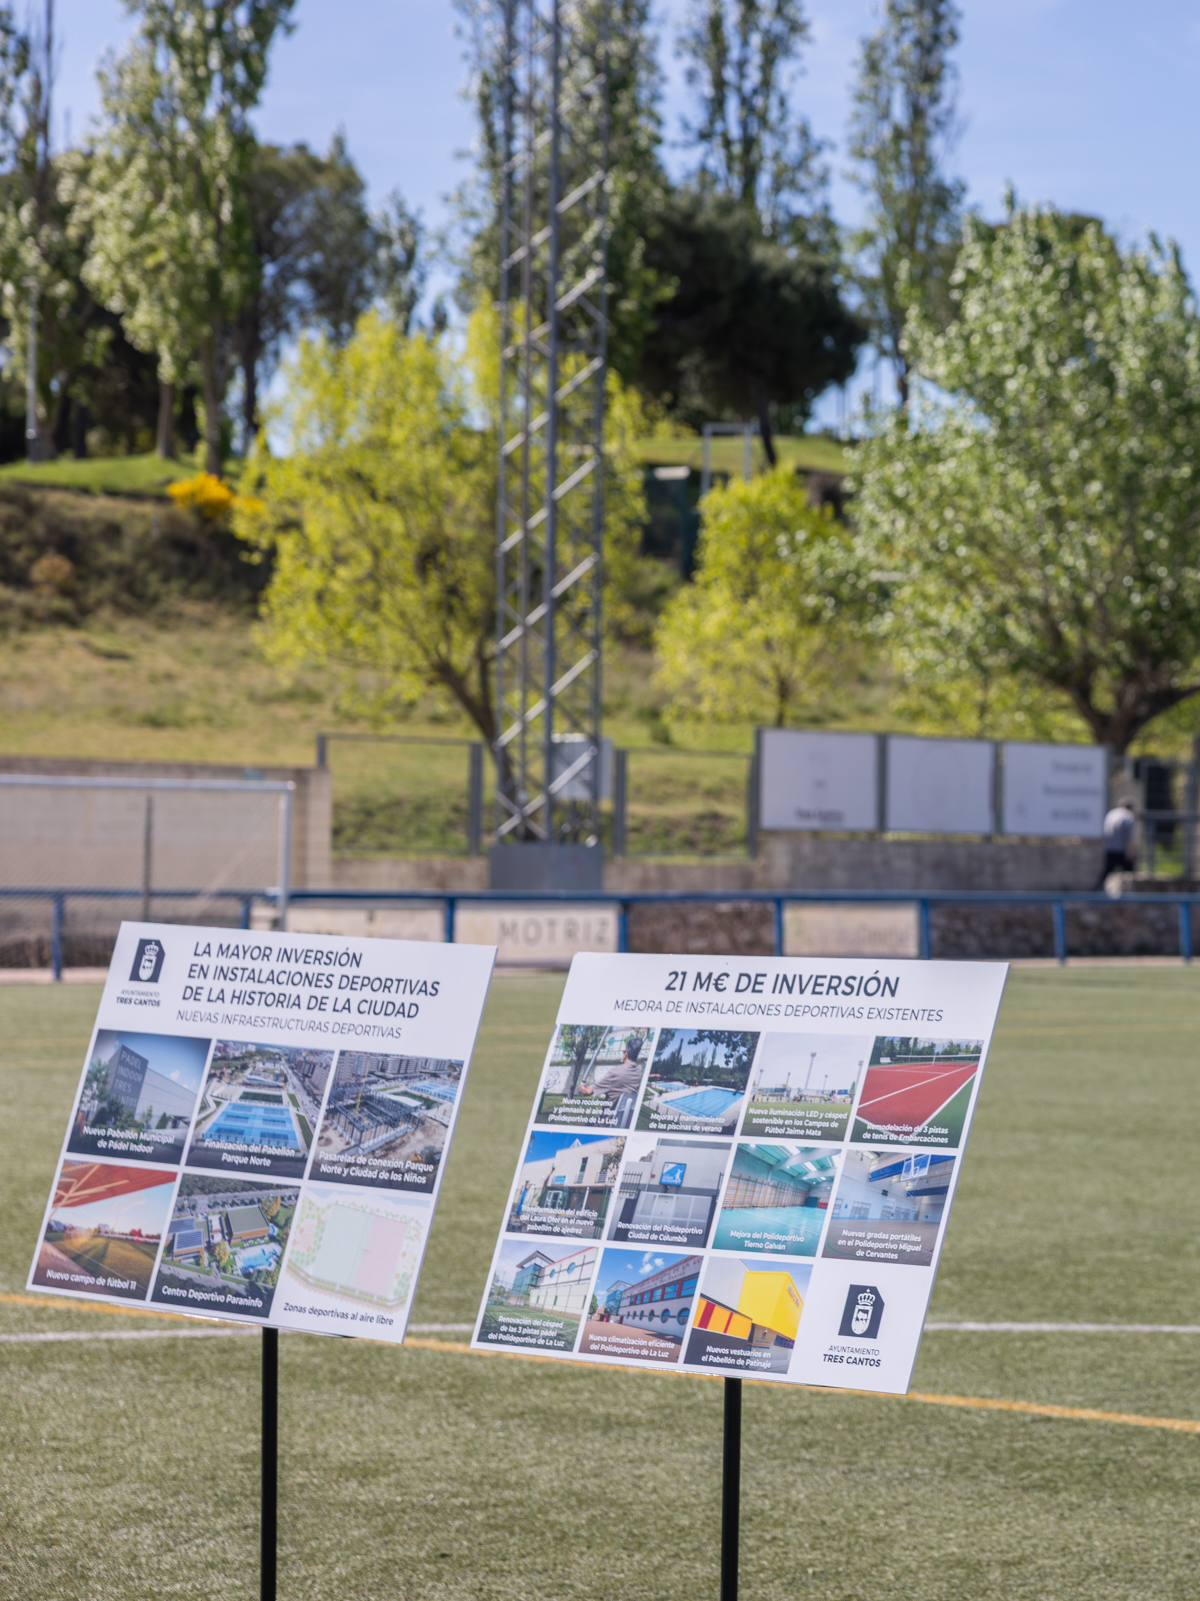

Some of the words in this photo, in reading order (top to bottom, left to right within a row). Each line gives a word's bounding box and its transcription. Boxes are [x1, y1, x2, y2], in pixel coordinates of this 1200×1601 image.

[499, 916, 608, 947] MOTRIZ
[194, 942, 212, 957] LA
[216, 943, 271, 962] MAYOR
[276, 947, 362, 968] INVERSIÓN
[188, 964, 208, 980] EN
[213, 966, 333, 989] INSTALACIONES
[339, 976, 440, 996] DEPORTIVAS
[665, 971, 687, 991] 21
[692, 972, 730, 993] M€
[735, 973, 767, 993] DE
[772, 970, 899, 998] INVERSIÓN
[116, 996, 132, 1005] TRES
[134, 998, 161, 1007] CANTOS
[182, 987, 202, 1001] DE
[208, 988, 225, 1002] LA
[231, 989, 301, 1010] HISTORIA
[307, 996, 328, 1011] DE
[333, 998, 351, 1013] LA
[357, 1000, 419, 1018] CIUDAD
[614, 999, 662, 1012] MEJORA
[666, 1000, 683, 1013] DE
[685, 1002, 781, 1017] INSTALACIONES
[784, 1005, 864, 1019] DEPORTIVAS
[867, 1007, 943, 1022] EXISTENTES
[177, 1011, 219, 1024] NUEVAS
[221, 1013, 329, 1033] INFRAESTRUCTURAS
[332, 1022, 402, 1039] DEPORTIVAS
[650, 1113, 673, 1122] Mejoras
[680, 1115, 725, 1123] mantenimiento
[749, 1108, 767, 1116] Nueva
[769, 1108, 805, 1118] iluminación
[806, 1110, 818, 1118] LED
[826, 1111, 847, 1120] césped
[752, 1117, 783, 1126] sostenible
[794, 1119, 803, 1127] los
[804, 1120, 829, 1128] Campos
[867, 1124, 913, 1133] Remodelación
[914, 1125, 922, 1133] de
[929, 1126, 949, 1135] pistas
[83, 1126, 105, 1137] Nuevo
[107, 1128, 138, 1140] Pabellón
[140, 1130, 174, 1144] Municipal
[765, 1127, 784, 1135] Fútbol
[786, 1127, 804, 1136] Jaime
[806, 1128, 821, 1136] Mata
[872, 1132, 887, 1140] tenis
[889, 1133, 897, 1141] de
[899, 1134, 949, 1144] Embarcaciones
[98, 1140, 107, 1148] de
[108, 1140, 128, 1151] Pádel
[130, 1143, 153, 1153] Indoor
[204, 1139, 247, 1152] Finalización
[249, 1143, 261, 1153] del
[263, 1144, 295, 1157] Pabellón
[222, 1153, 248, 1166] Parque
[250, 1157, 272, 1167] Norte
[319, 1152, 355, 1163] Pasarelas
[357, 1156, 367, 1165] de
[368, 1155, 403, 1168] conexión
[405, 1160, 434, 1172] Parque
[320, 1164, 341, 1174] Norte
[342, 1168, 349, 1177] y
[350, 1167, 378, 1179] Ciudad
[379, 1170, 389, 1179] de
[391, 1172, 402, 1181] los
[403, 1173, 426, 1184] Niños
[617, 1221, 651, 1230] Renovación
[653, 1224, 662, 1232] del
[663, 1225, 703, 1235] Polideportivo
[628, 1231, 649, 1240] Ciudad
[658, 1234, 687, 1243] Columbia
[730, 1230, 751, 1239] Mejora
[763, 1232, 804, 1243] Polideportivo
[842, 1229, 865, 1239] Nuevas
[867, 1231, 889, 1241] gradas
[890, 1232, 921, 1243] portátiles
[744, 1240, 762, 1249] Tierno
[764, 1241, 786, 1250] Galván
[847, 1238, 854, 1246] el
[855, 1239, 897, 1250] Polideportivo
[899, 1242, 921, 1252] Miguel
[867, 1249, 898, 1260] Cervantes
[46, 1269, 69, 1281] Nuevo
[71, 1275, 94, 1286] campo
[96, 1276, 106, 1286] de
[107, 1276, 129, 1289] fútbol
[130, 1280, 136, 1290] 11
[162, 1285, 187, 1296] Centro
[188, 1289, 225, 1302] Deportivo
[226, 1294, 263, 1307] Paraninfo
[283, 1303, 306, 1313] Zonas
[308, 1306, 348, 1320] deportivas
[350, 1312, 357, 1320] al
[360, 1312, 374, 1322] aire
[376, 1315, 394, 1325] libre
[498, 1315, 531, 1326] Renovación
[532, 1319, 542, 1327] del
[543, 1320, 564, 1329] césped
[522, 1327, 539, 1336] pistas
[540, 1328, 557, 1337] pádel
[488, 1332, 498, 1340] del
[499, 1333, 536, 1345] Polideportivo
[554, 1339, 565, 1347] Luz
[589, 1334, 607, 1343] Nueva
[608, 1334, 647, 1347] climatización
[648, 1340, 675, 1349] eficiente
[590, 1343, 600, 1351] del
[601, 1344, 638, 1356] Polideportivo
[639, 1348, 649, 1356] de
[650, 1349, 657, 1357] La
[658, 1350, 669, 1358] Luz
[706, 1345, 728, 1354] Nuevos
[730, 1347, 761, 1357] vestuarios
[828, 1345, 880, 1356] AYUNTAMIENTO
[708, 1354, 735, 1365] Pabellón
[736, 1356, 744, 1365] de
[746, 1357, 772, 1369] Patinaje
[823, 1354, 844, 1363] TRES
[846, 1356, 881, 1367] CANTOS
